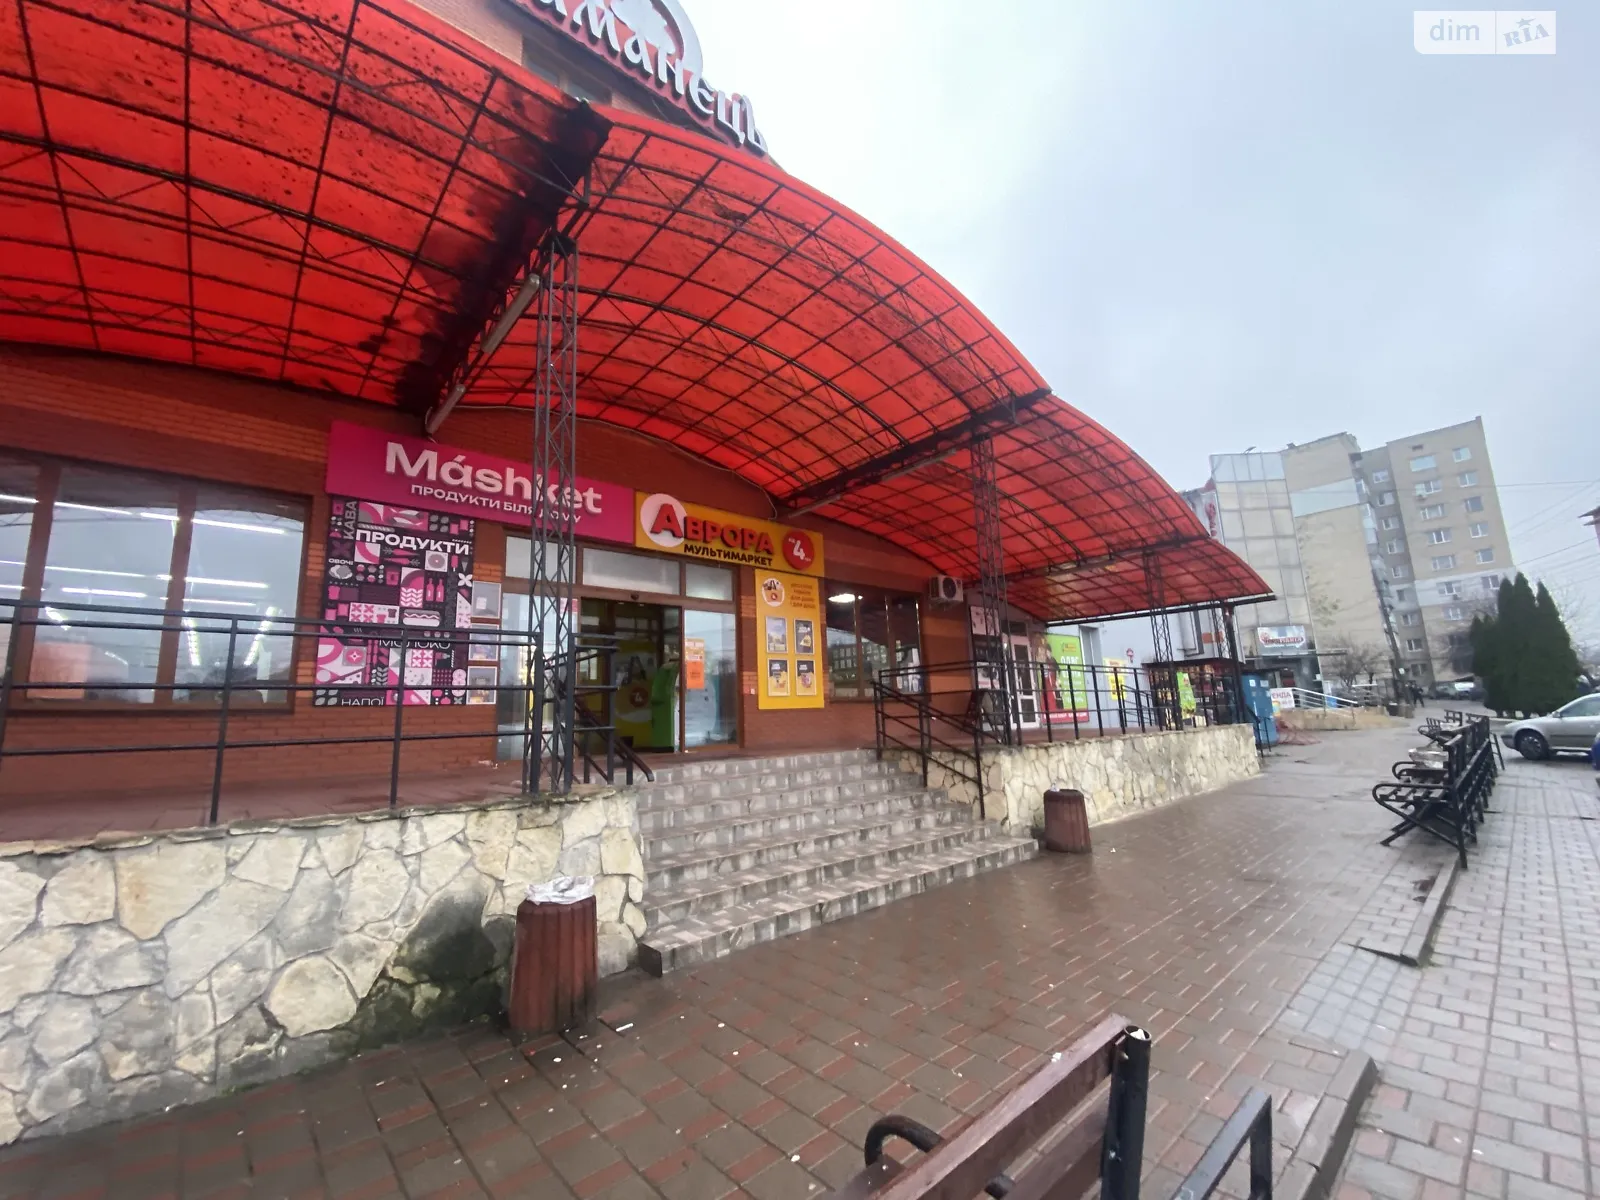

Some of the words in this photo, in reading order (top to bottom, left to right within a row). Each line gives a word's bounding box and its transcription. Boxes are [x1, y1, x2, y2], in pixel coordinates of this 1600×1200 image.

[385, 441, 603, 514] Máshket
[410, 484, 500, 509] ПРОДУКТИ
[343, 501, 357, 540] КАВА
[650, 503, 775, 555] АВРОРА
[355, 530, 470, 556] ПРОДУКТИ
[683, 543, 774, 566] МУЛЬТИМАРКЕТ
[328, 557, 354, 566] ОВОЧІ
[341, 696, 385, 706] НАПОЇ
